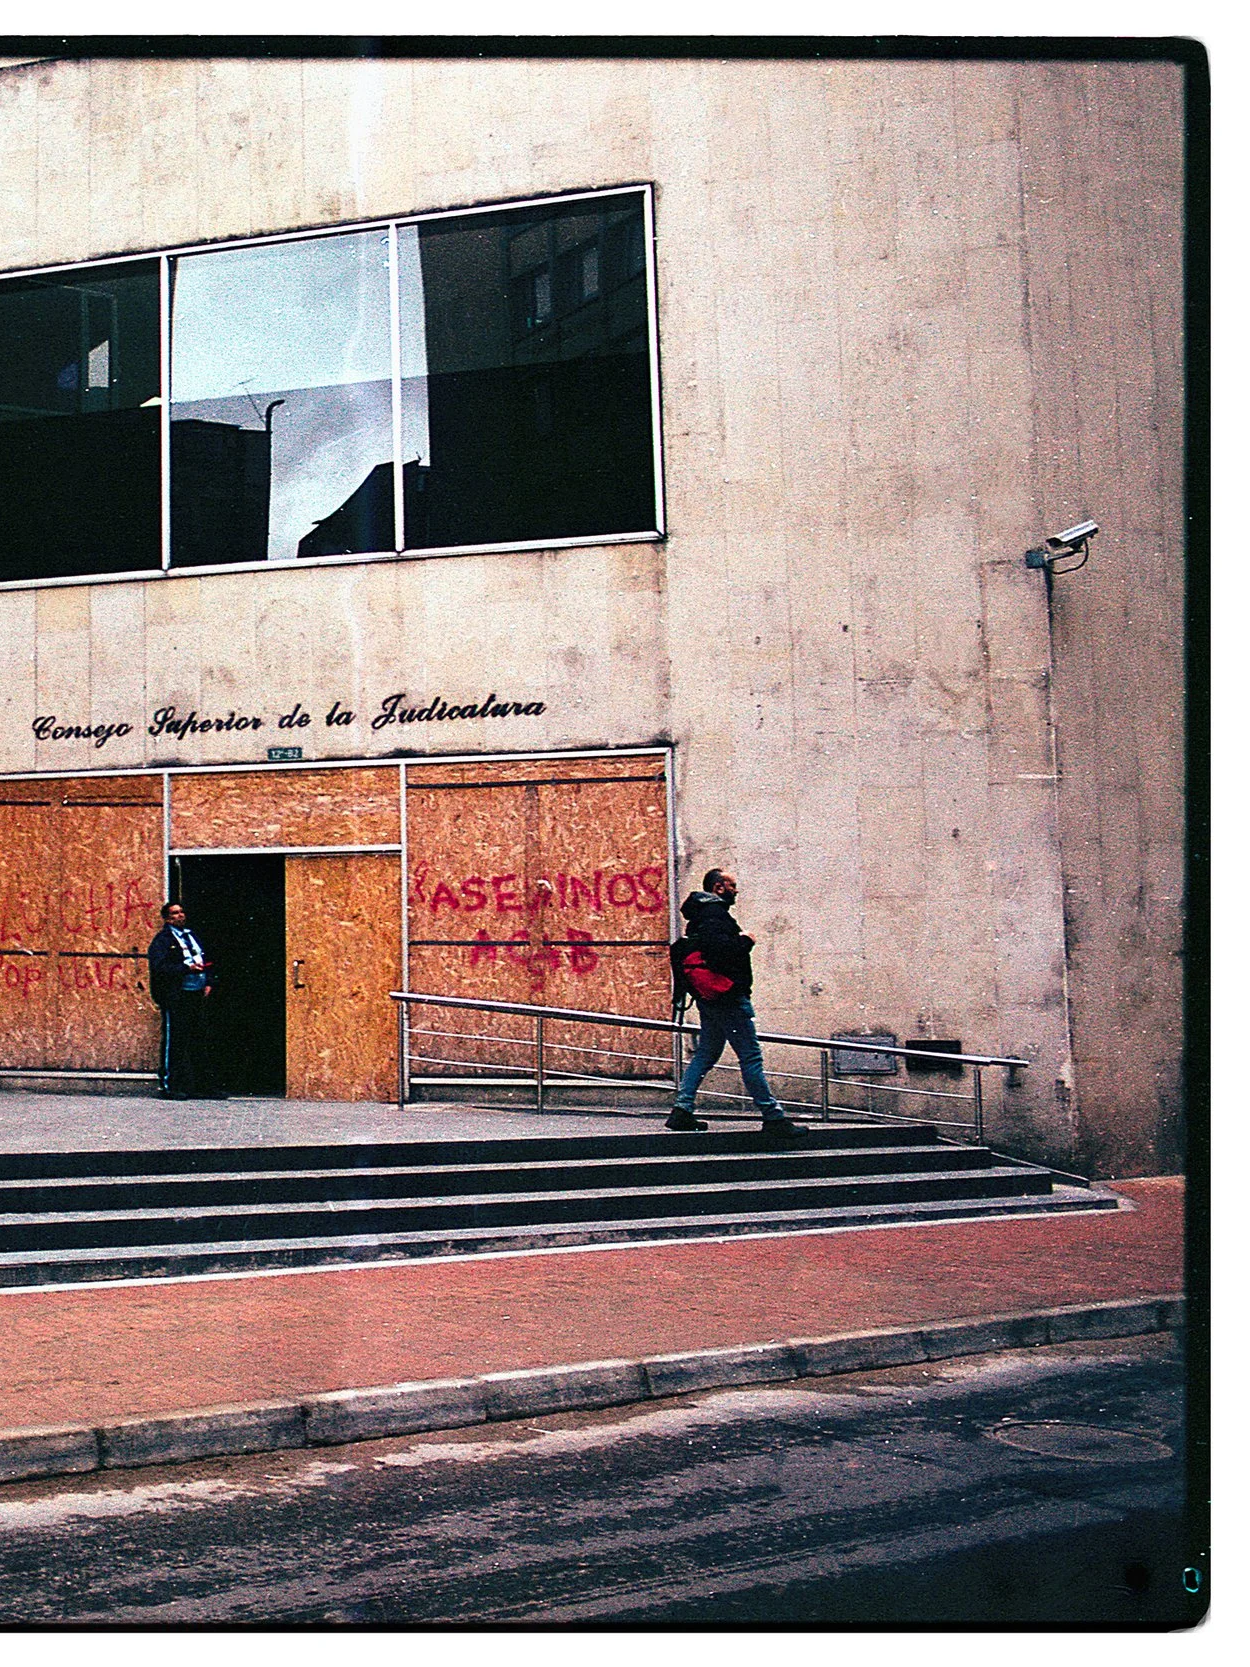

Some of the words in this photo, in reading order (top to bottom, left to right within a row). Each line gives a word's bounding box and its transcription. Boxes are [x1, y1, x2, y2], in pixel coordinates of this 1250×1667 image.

[32, 716, 134, 748] Consejo
[149, 706, 263, 740] Superior
[278, 703, 312, 729] de
[326, 701, 356, 727] la
[371, 693, 547, 730] Judicatura
